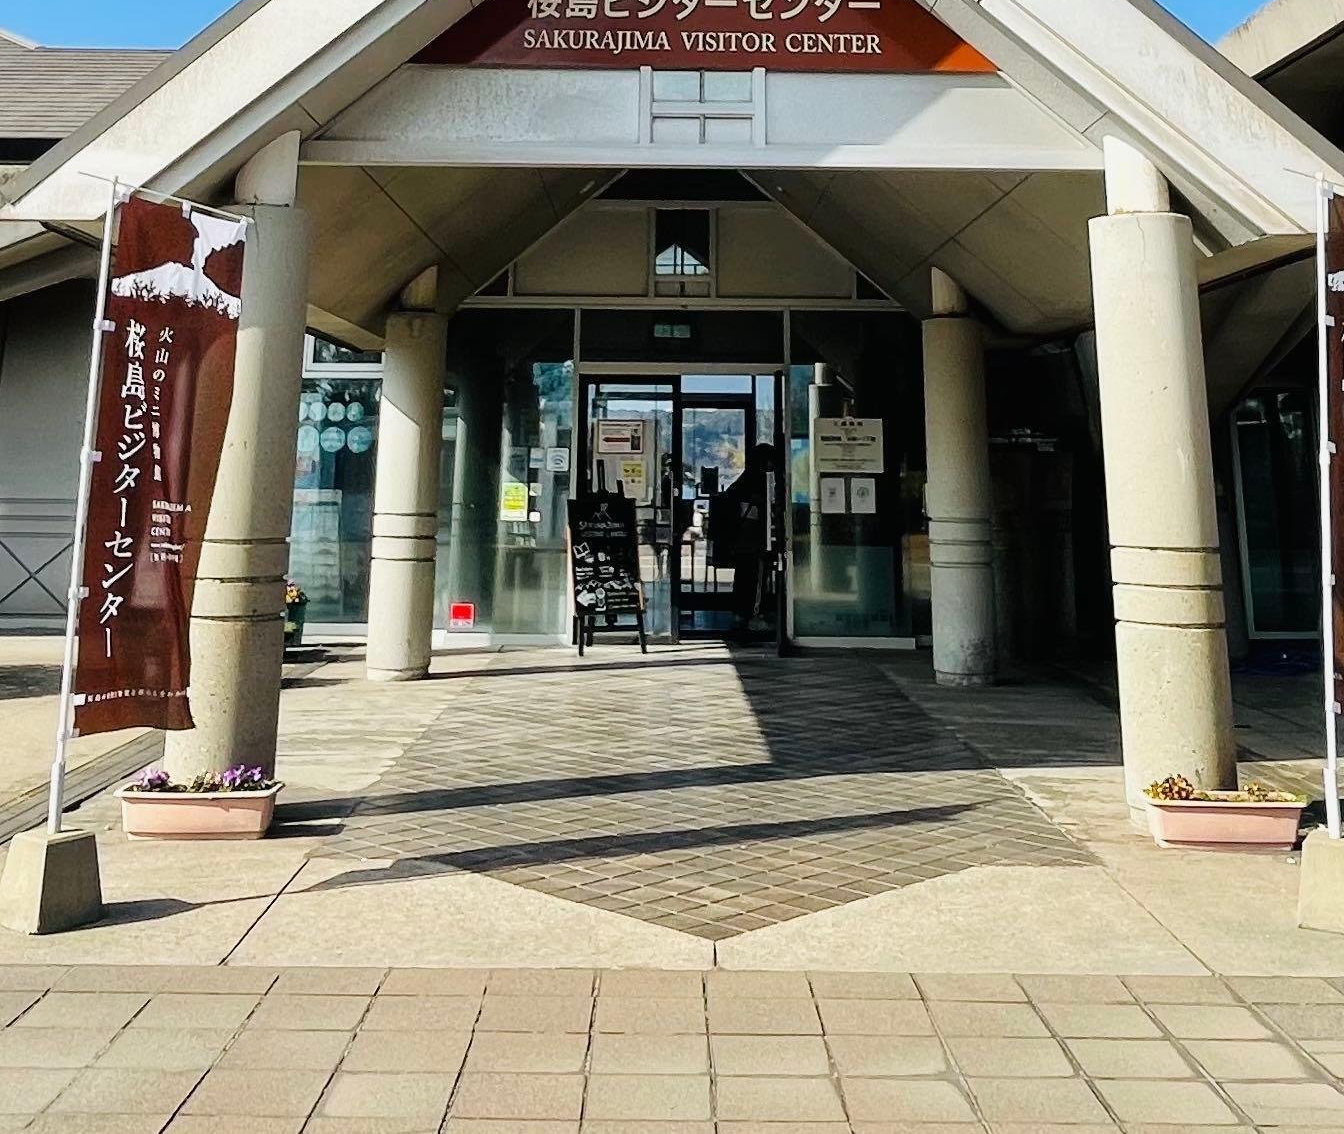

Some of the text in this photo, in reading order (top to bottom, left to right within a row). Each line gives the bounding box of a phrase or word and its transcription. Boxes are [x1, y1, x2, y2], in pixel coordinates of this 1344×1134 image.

[523, 29, 882, 54] SAKURAJIMA VISITOR CENTER
[99, 318, 148, 658] 桜島ビジターセンター
